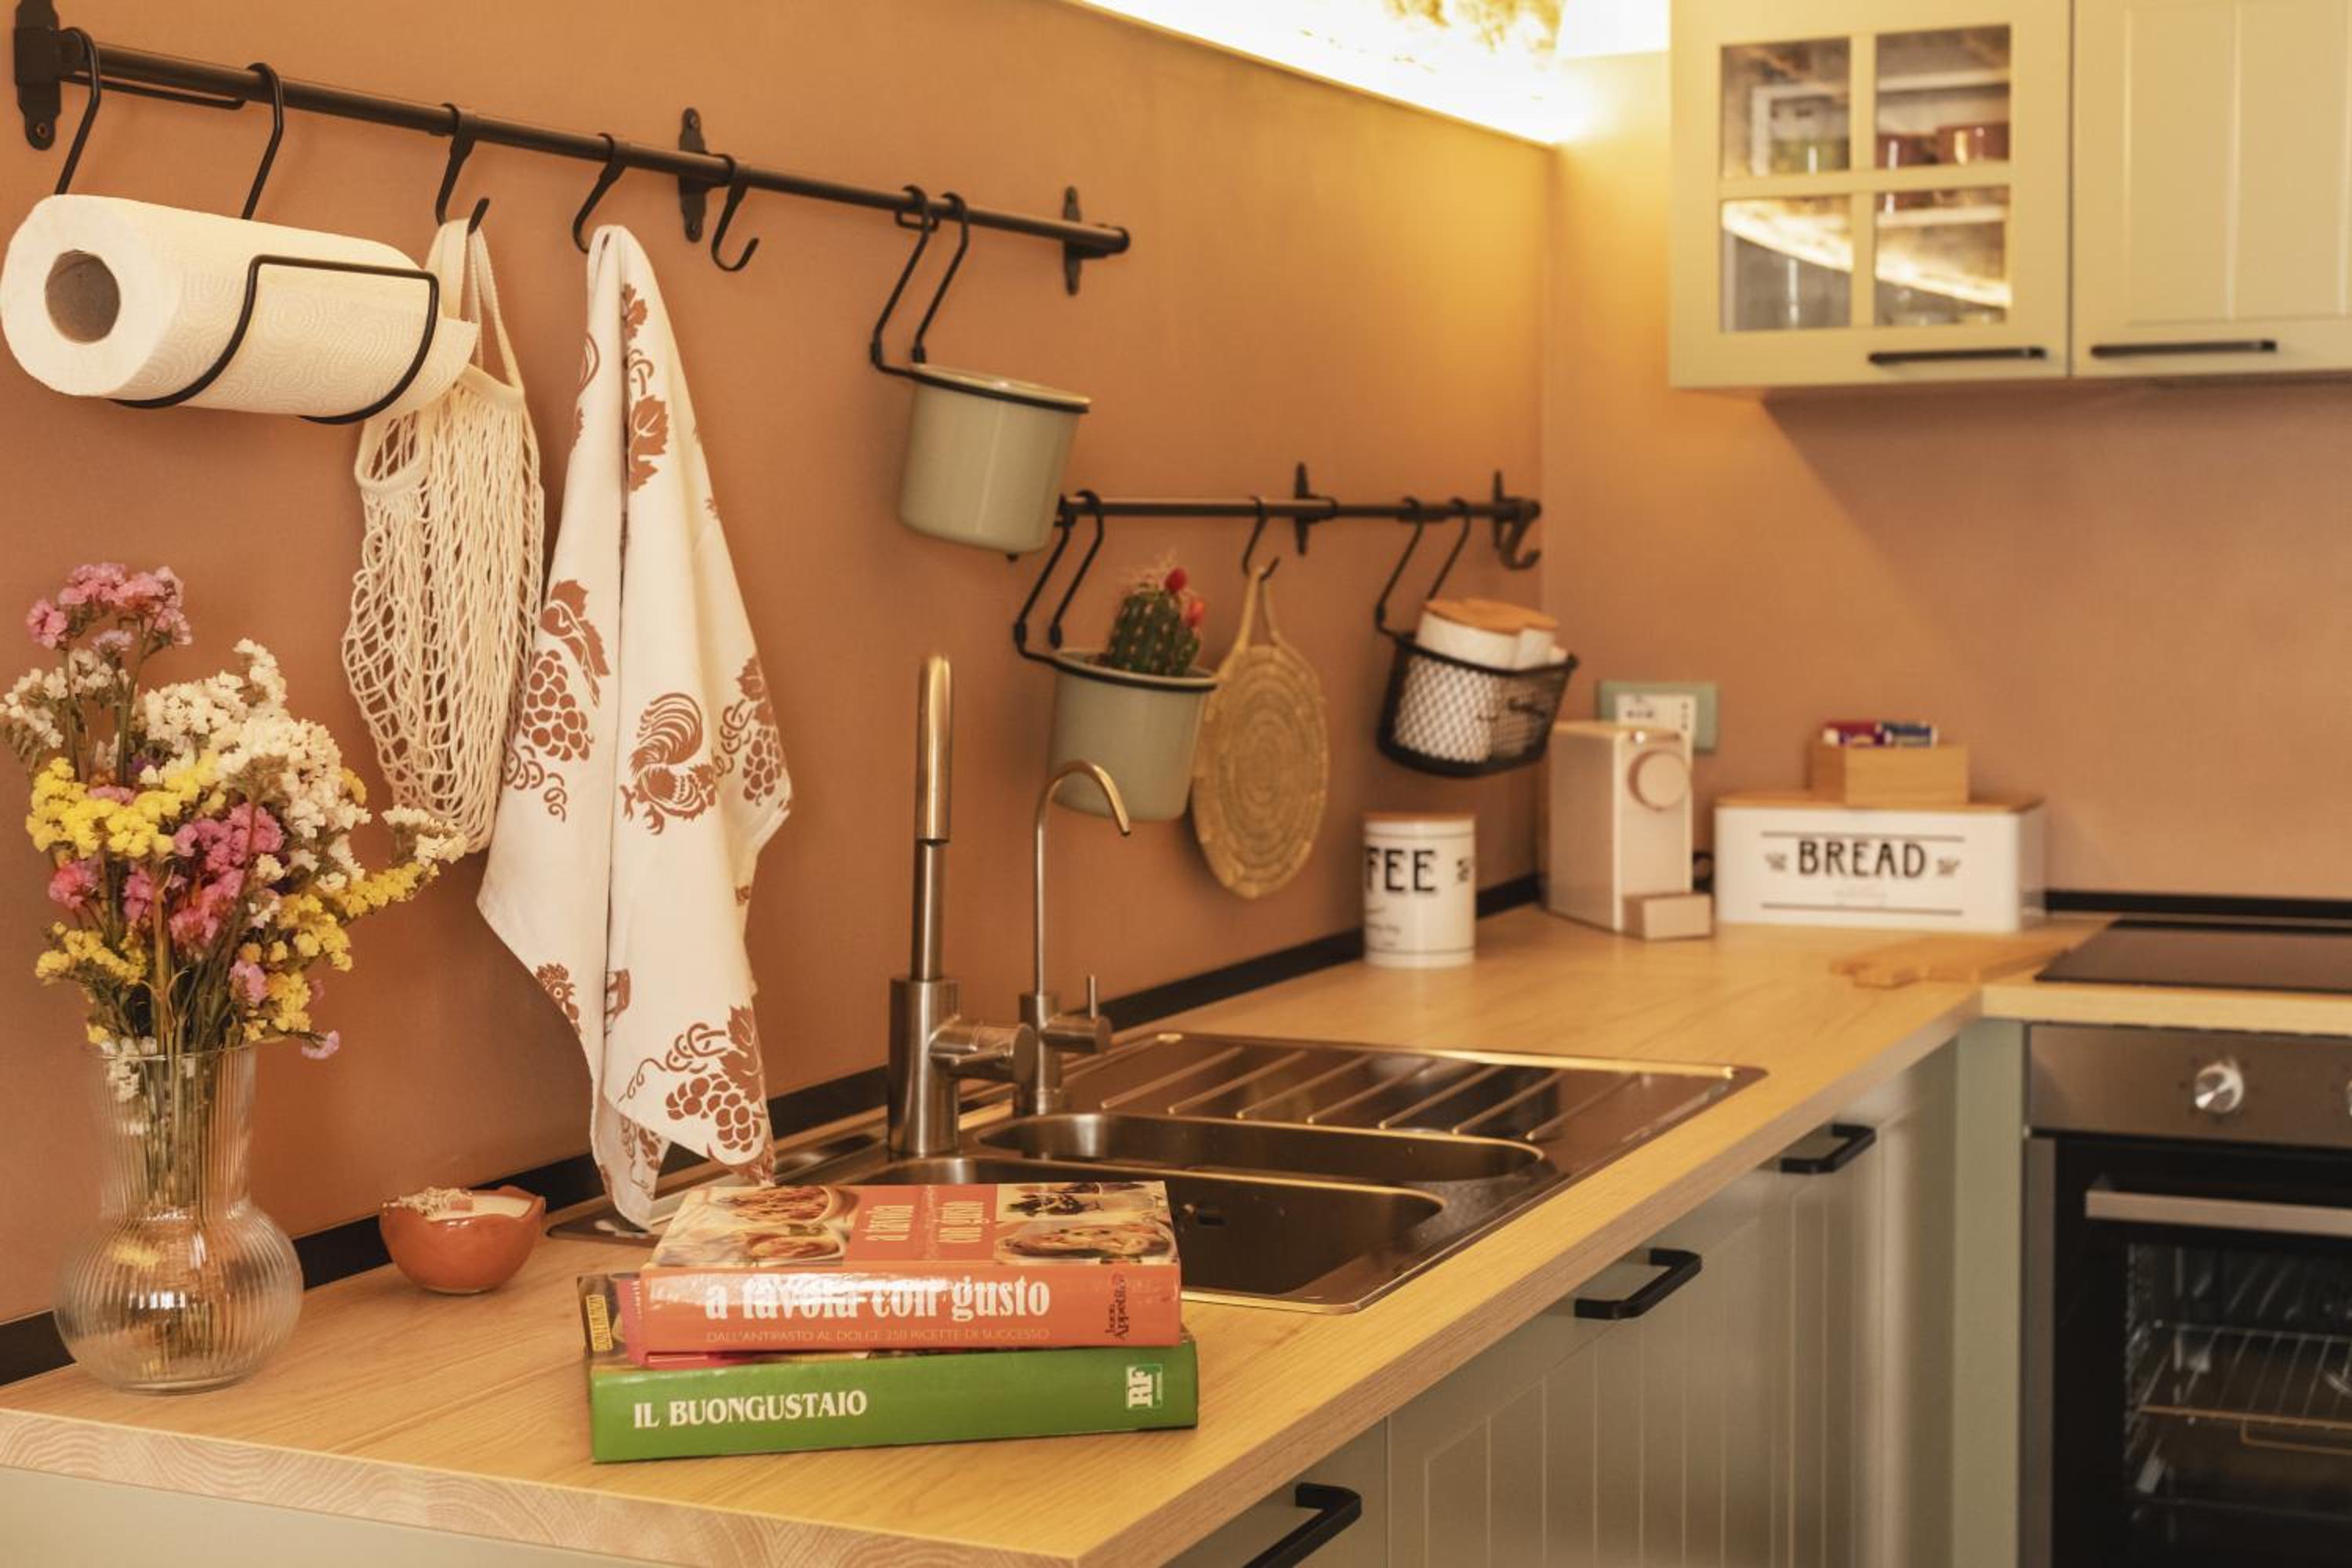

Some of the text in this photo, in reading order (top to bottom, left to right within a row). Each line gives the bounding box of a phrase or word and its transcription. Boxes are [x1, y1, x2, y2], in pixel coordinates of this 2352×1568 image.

[1798, 840, 1926, 878] BREAD
[706, 1283, 728, 1319] a
[872, 1280, 938, 1318] con
[951, 1275, 1050, 1322] gusto
[633, 1389, 868, 1428] IL BUONGUSTAIO
